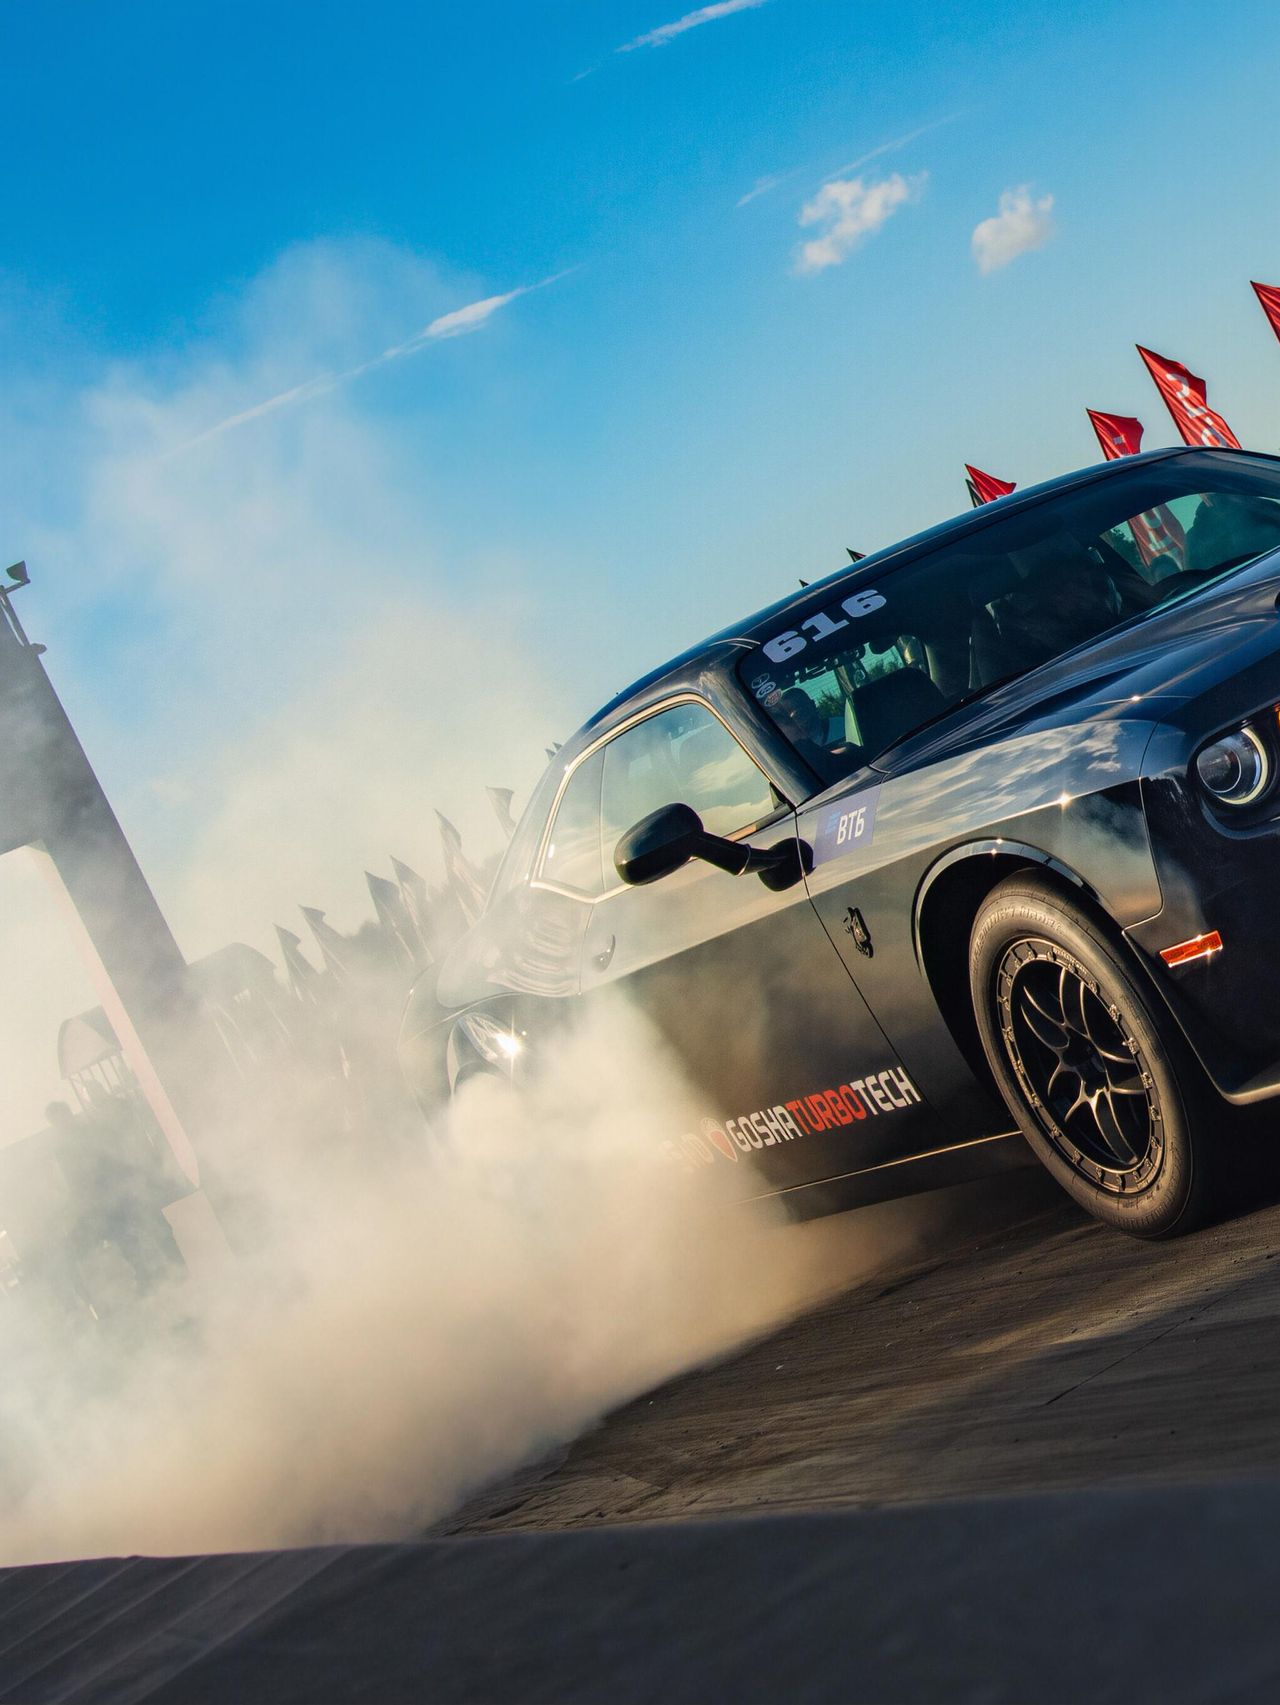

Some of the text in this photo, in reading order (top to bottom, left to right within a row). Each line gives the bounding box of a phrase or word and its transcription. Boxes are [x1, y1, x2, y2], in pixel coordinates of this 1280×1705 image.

[762, 589, 887, 664] 616
[836, 806, 867, 845] ВТБ
[725, 1066, 922, 1153] GOSHATURBOTECH
